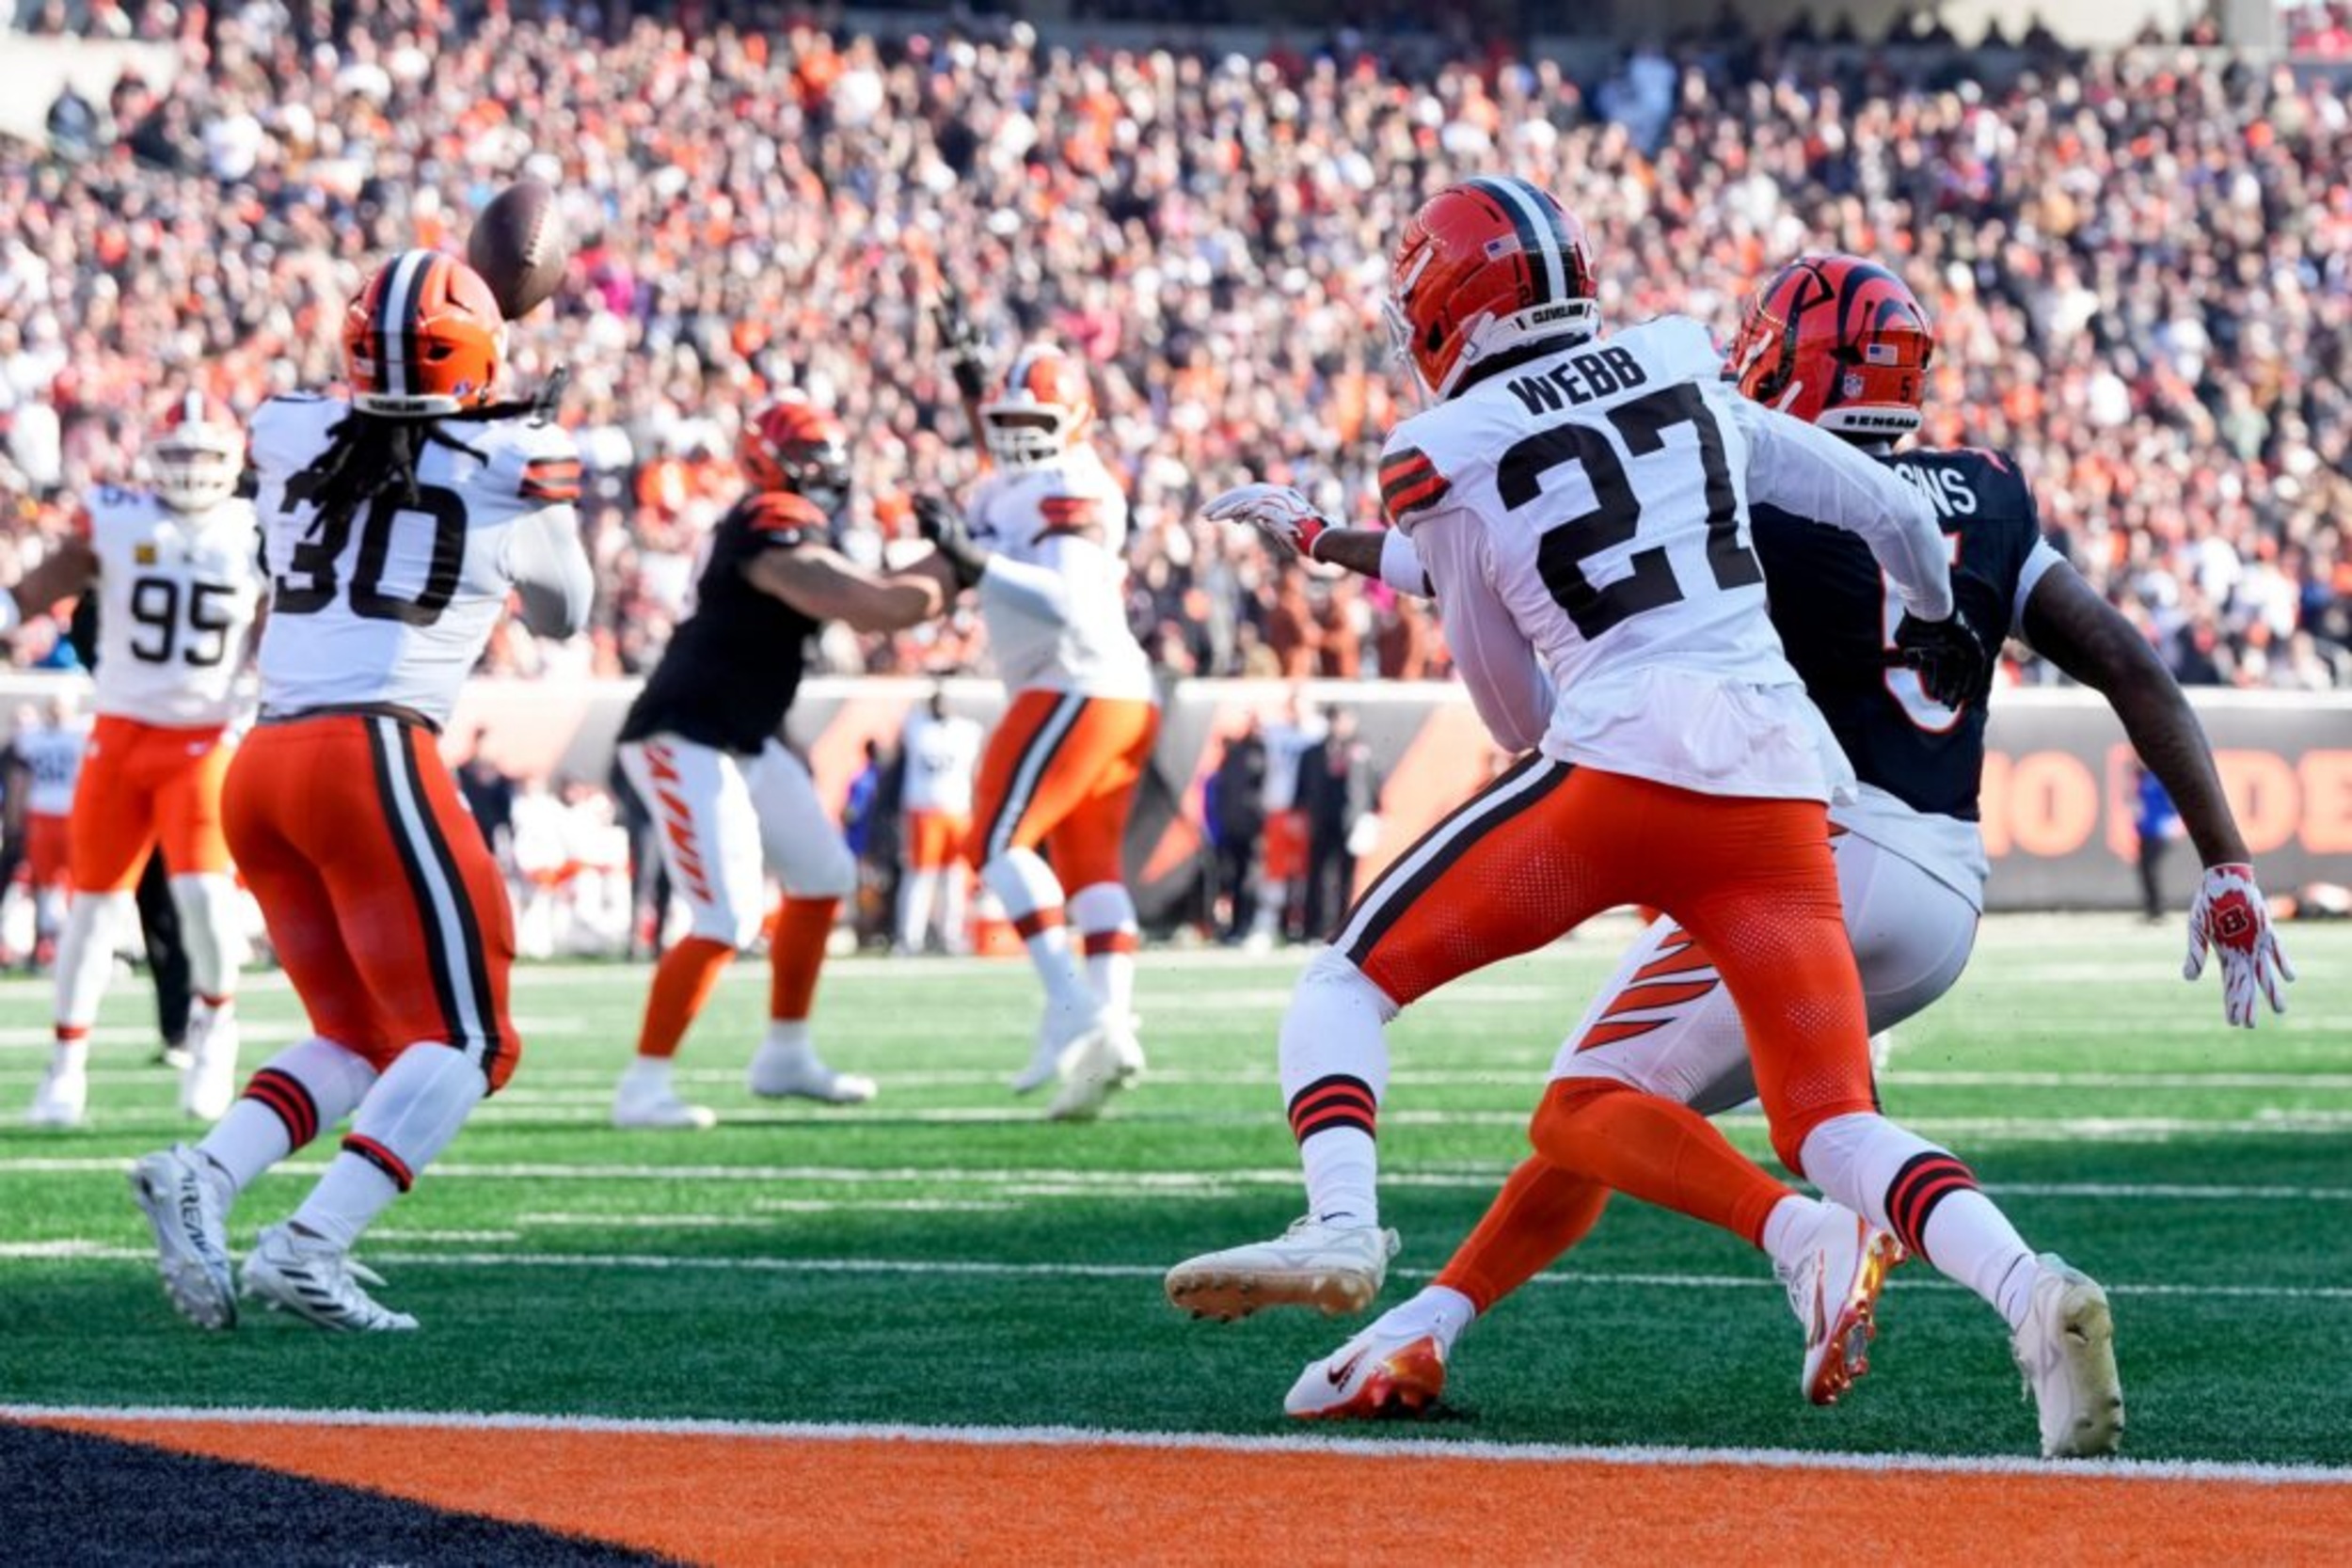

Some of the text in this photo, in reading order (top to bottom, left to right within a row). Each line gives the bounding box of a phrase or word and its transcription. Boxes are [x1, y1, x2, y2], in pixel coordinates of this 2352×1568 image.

[1506, 346, 1647, 416] WEBB
[1899, 376, 1912, 403] 5
[1843, 414, 1918, 429] BENGALS
[274, 469, 468, 627] 30
[1496, 381, 1765, 641] 27
[130, 577, 238, 667] 95
